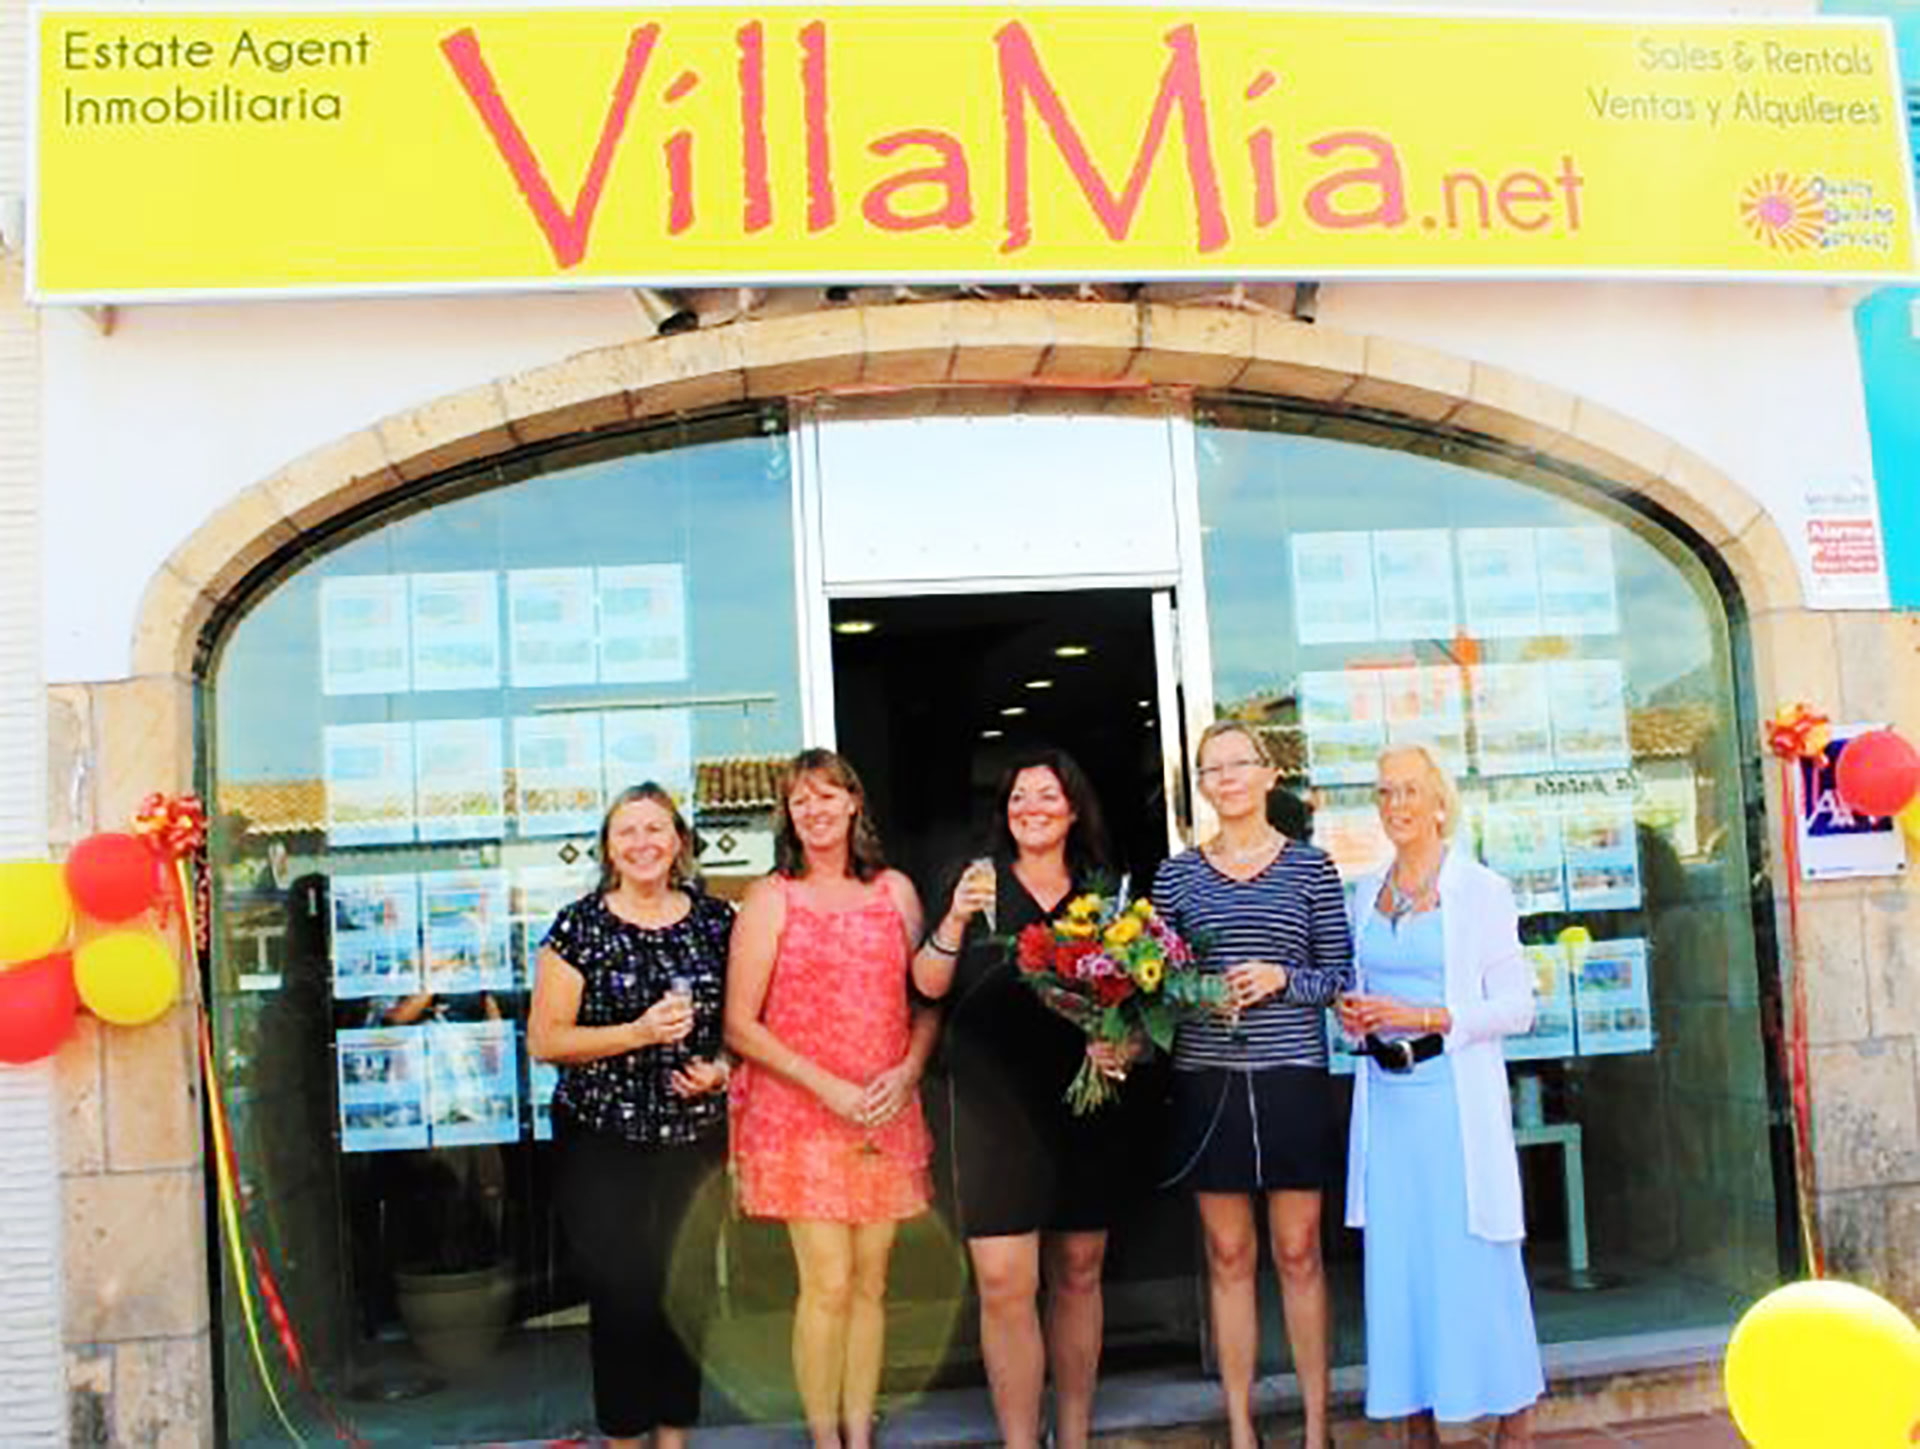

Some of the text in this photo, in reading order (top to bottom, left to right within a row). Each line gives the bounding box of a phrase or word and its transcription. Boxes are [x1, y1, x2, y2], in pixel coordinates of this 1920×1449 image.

[64, 30, 371, 72] Estate Agent
[1639, 39, 1875, 77] Sales & Rentals
[64, 86, 342, 126] Inmobiliaria
[1587, 87, 1881, 128] Ventas y Alquileres
